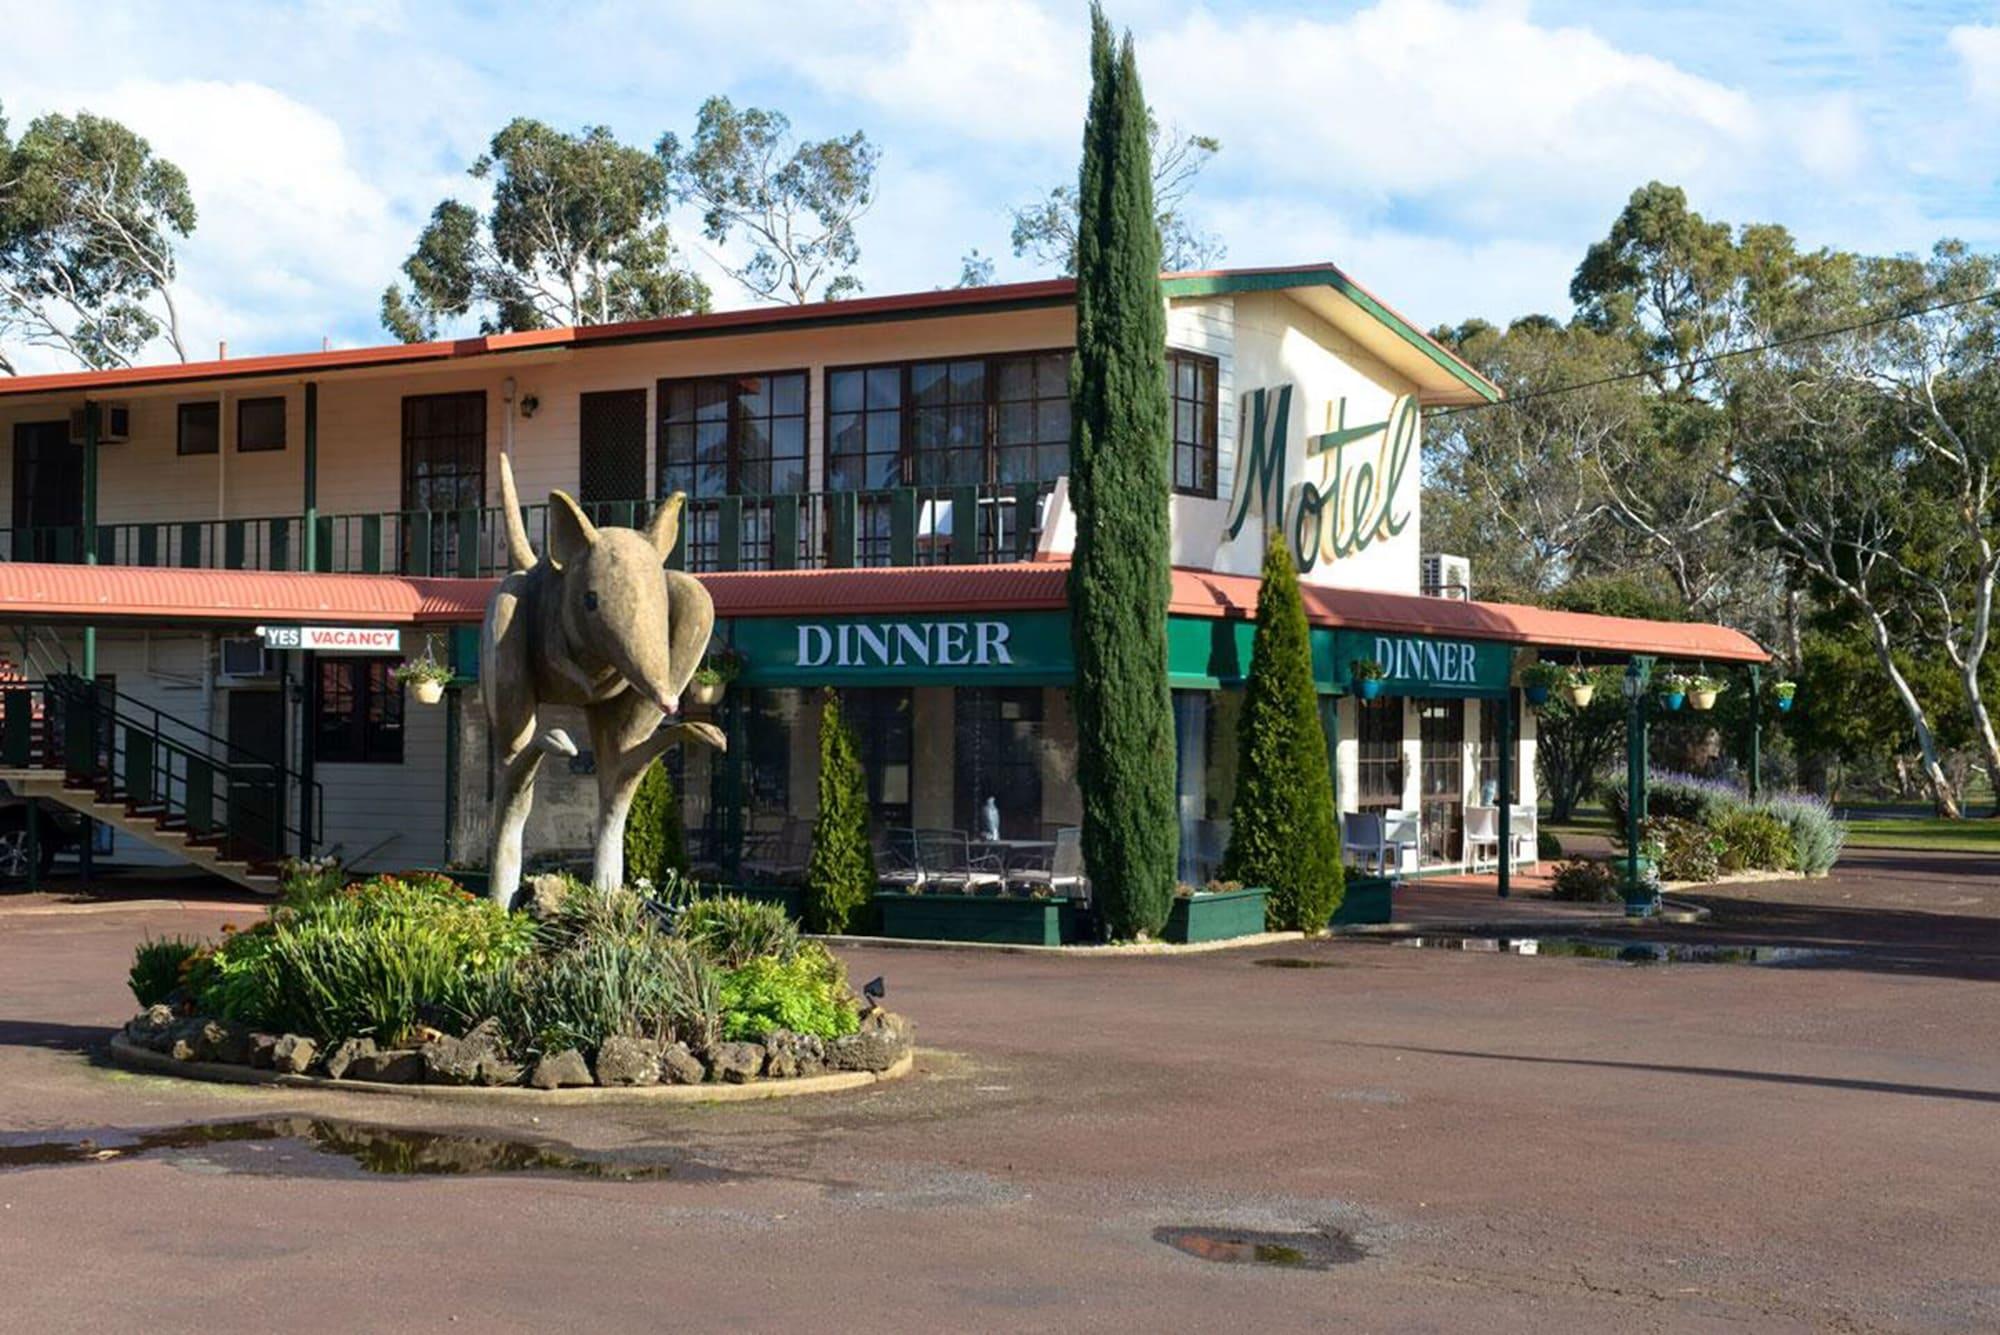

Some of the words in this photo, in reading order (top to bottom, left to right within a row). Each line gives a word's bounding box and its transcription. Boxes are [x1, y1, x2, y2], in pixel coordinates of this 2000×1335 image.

[1225, 384, 1418, 573] Motel
[268, 629, 299, 645] YES
[311, 631, 395, 646] VACANCY
[795, 622, 1014, 666] DINNER
[1375, 637, 1477, 682] DINNER
